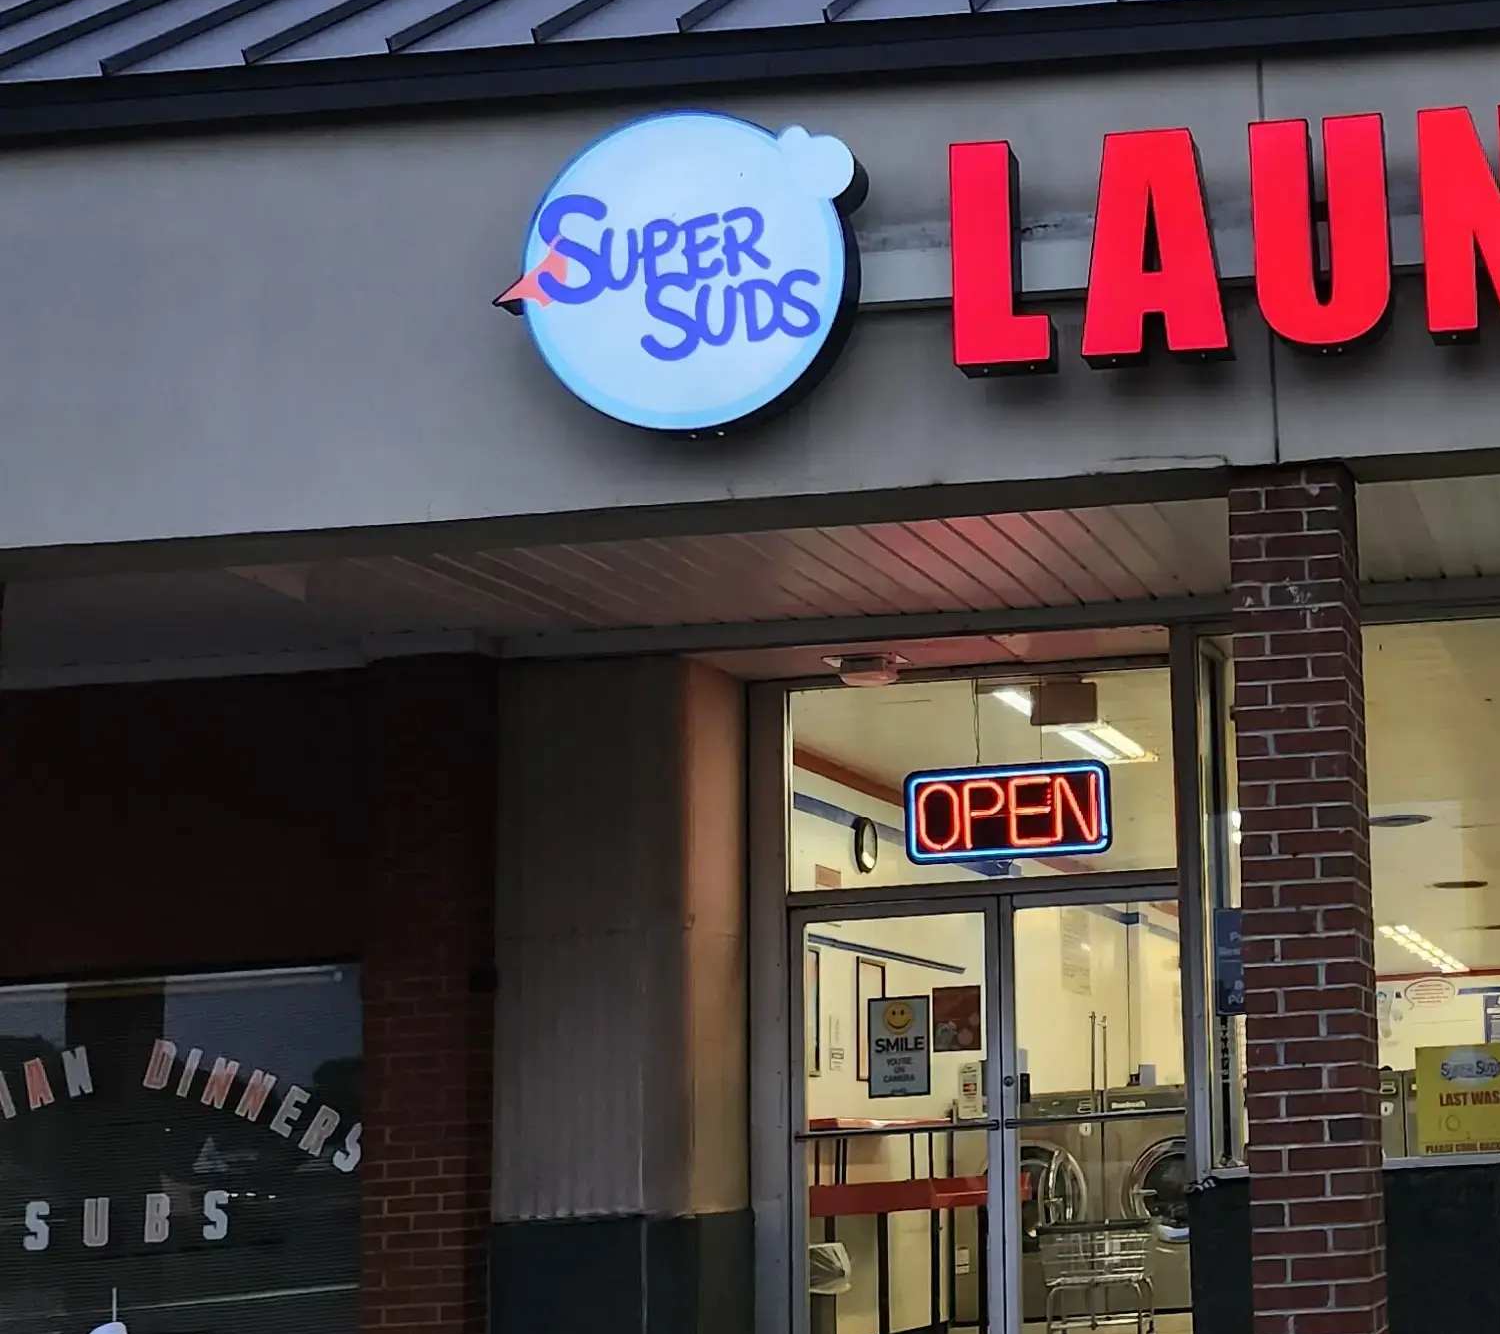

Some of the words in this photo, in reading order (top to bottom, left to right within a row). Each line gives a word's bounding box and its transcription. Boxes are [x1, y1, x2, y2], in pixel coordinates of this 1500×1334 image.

[537, 193, 772, 305] SUPER
[640, 269, 822, 361] SUDS
[917, 772, 1099, 851] OPEN
[875, 1035, 925, 1054] SMILE
[142, 1038, 363, 1173] DINNERS
[1439, 1091, 1469, 1107] LAST
[23, 1189, 229, 1251] SUBS
